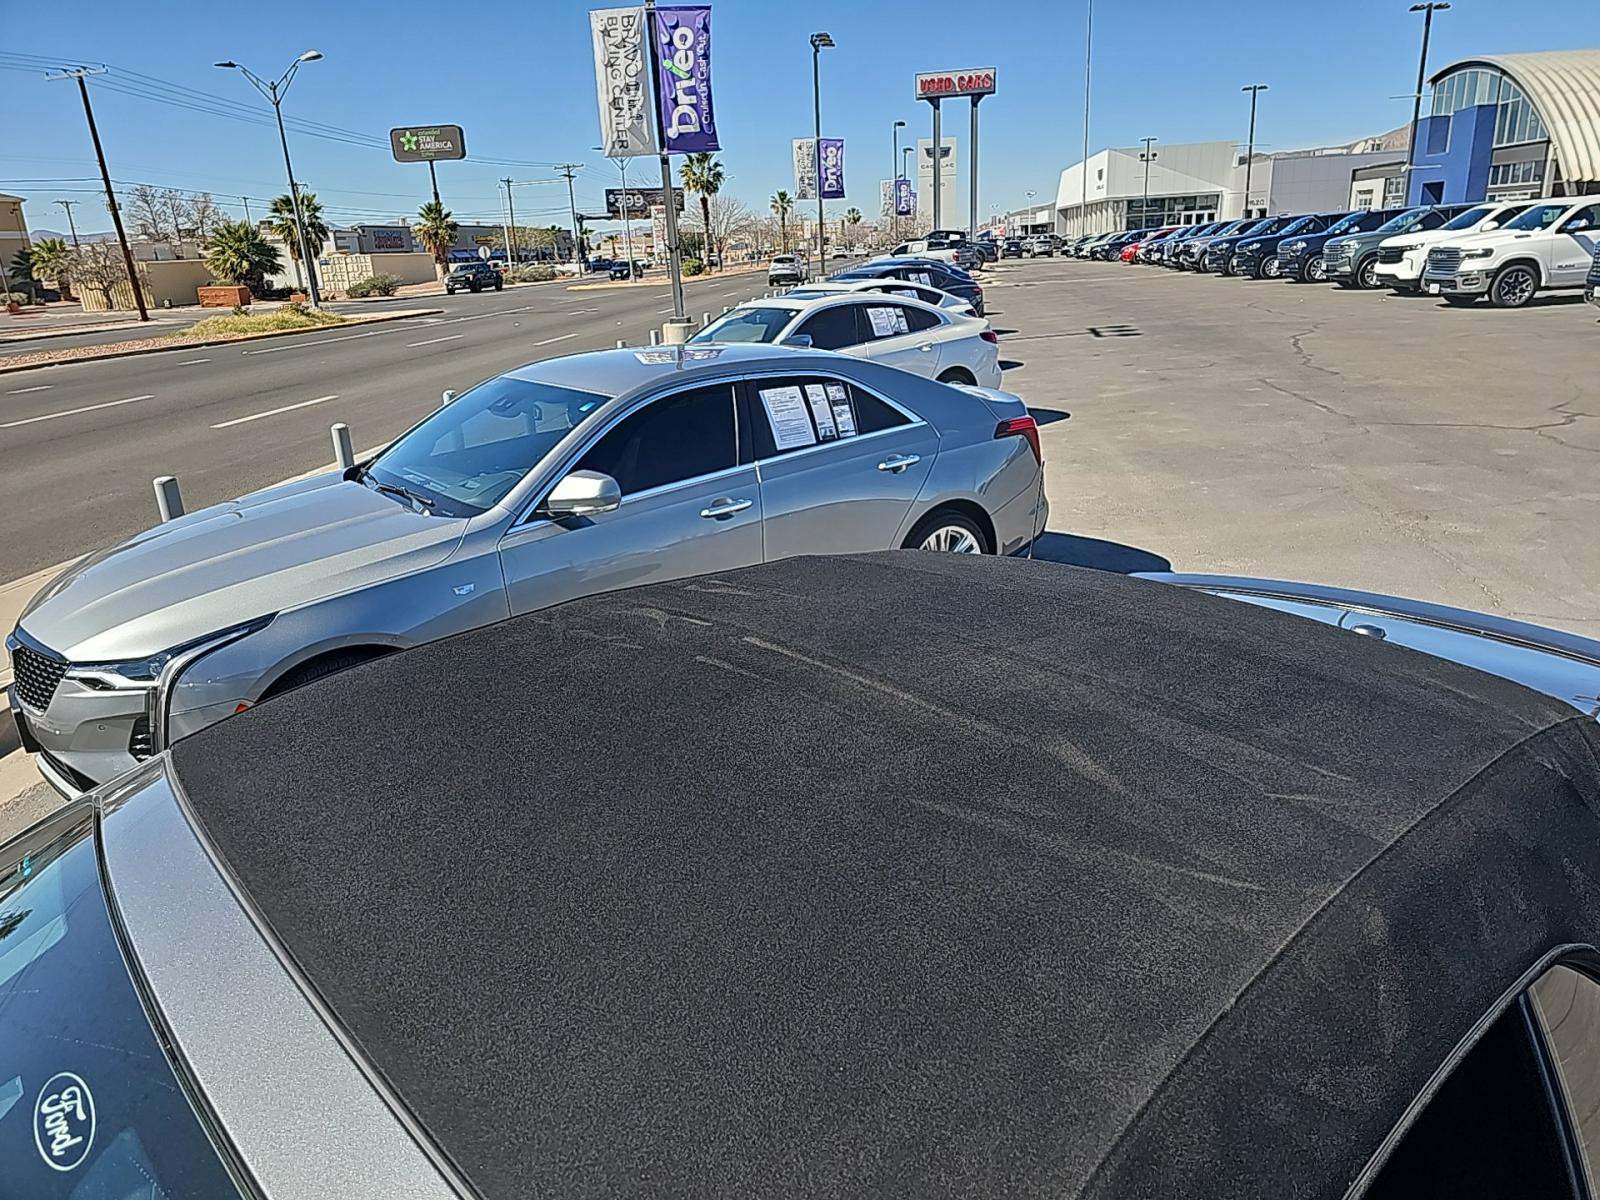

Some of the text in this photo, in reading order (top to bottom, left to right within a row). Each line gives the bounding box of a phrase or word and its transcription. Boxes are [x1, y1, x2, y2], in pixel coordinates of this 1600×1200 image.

[621, 15, 642, 78] BRAVO
[606, 16, 629, 150] BUYING CENTER
[920, 73, 992, 93] USED CARS
[419, 141, 453, 150] AMERICA
[608, 194, 644, 207] $399
[41, 1086, 87, 1156] Ford
